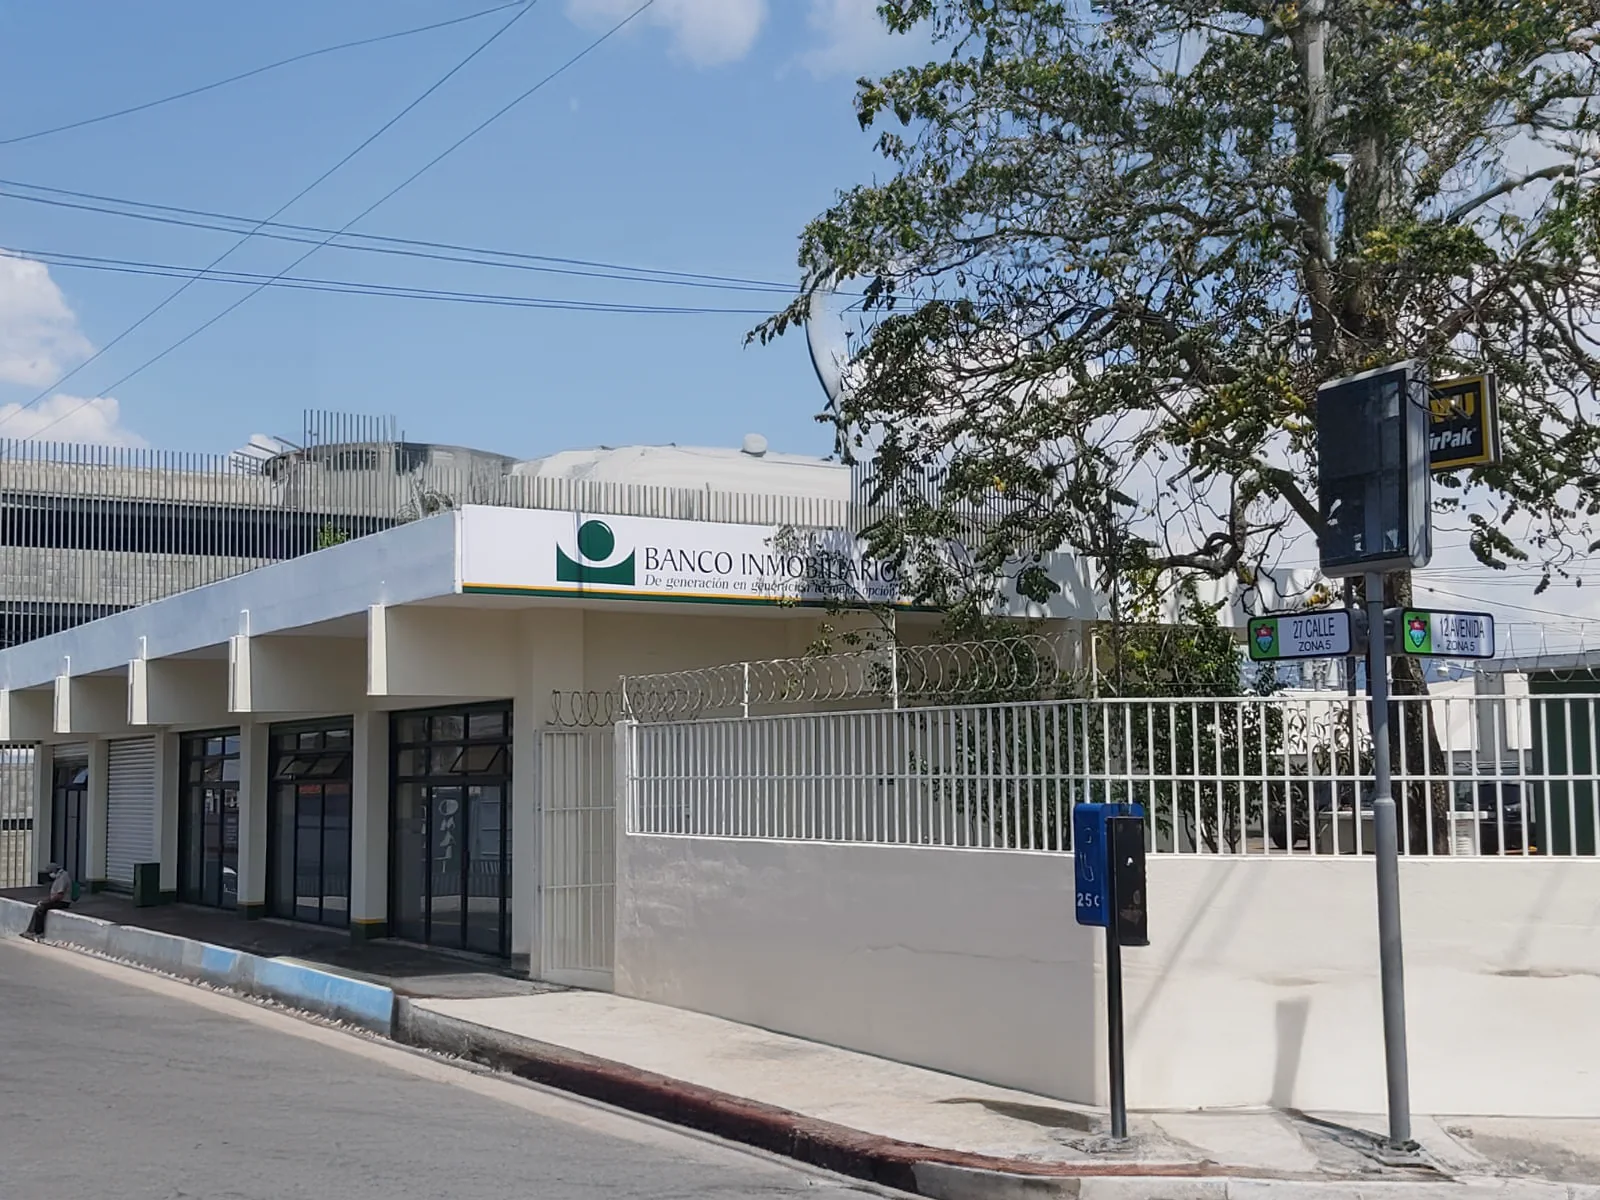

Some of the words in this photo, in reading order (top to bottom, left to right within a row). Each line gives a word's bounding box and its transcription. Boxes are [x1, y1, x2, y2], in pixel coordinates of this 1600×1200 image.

[1429, 427, 1473, 451] irPak
[645, 547, 733, 575] BANCO
[742, 553, 898, 583] INMOBILIARIO
[644, 574, 662, 586] De
[666, 577, 729, 591] generación
[733, 581, 747, 590] en
[1293, 620, 1303, 639] 27
[1306, 617, 1335, 638] CALLE
[1440, 617, 1449, 637] 12
[1450, 617, 1485, 639] AVENIDA
[1298, 641, 1325, 652] ZONA
[1325, 640, 1332, 650] 5
[1446, 640, 1469, 651] ZONA
[1470, 641, 1476, 652] 5
